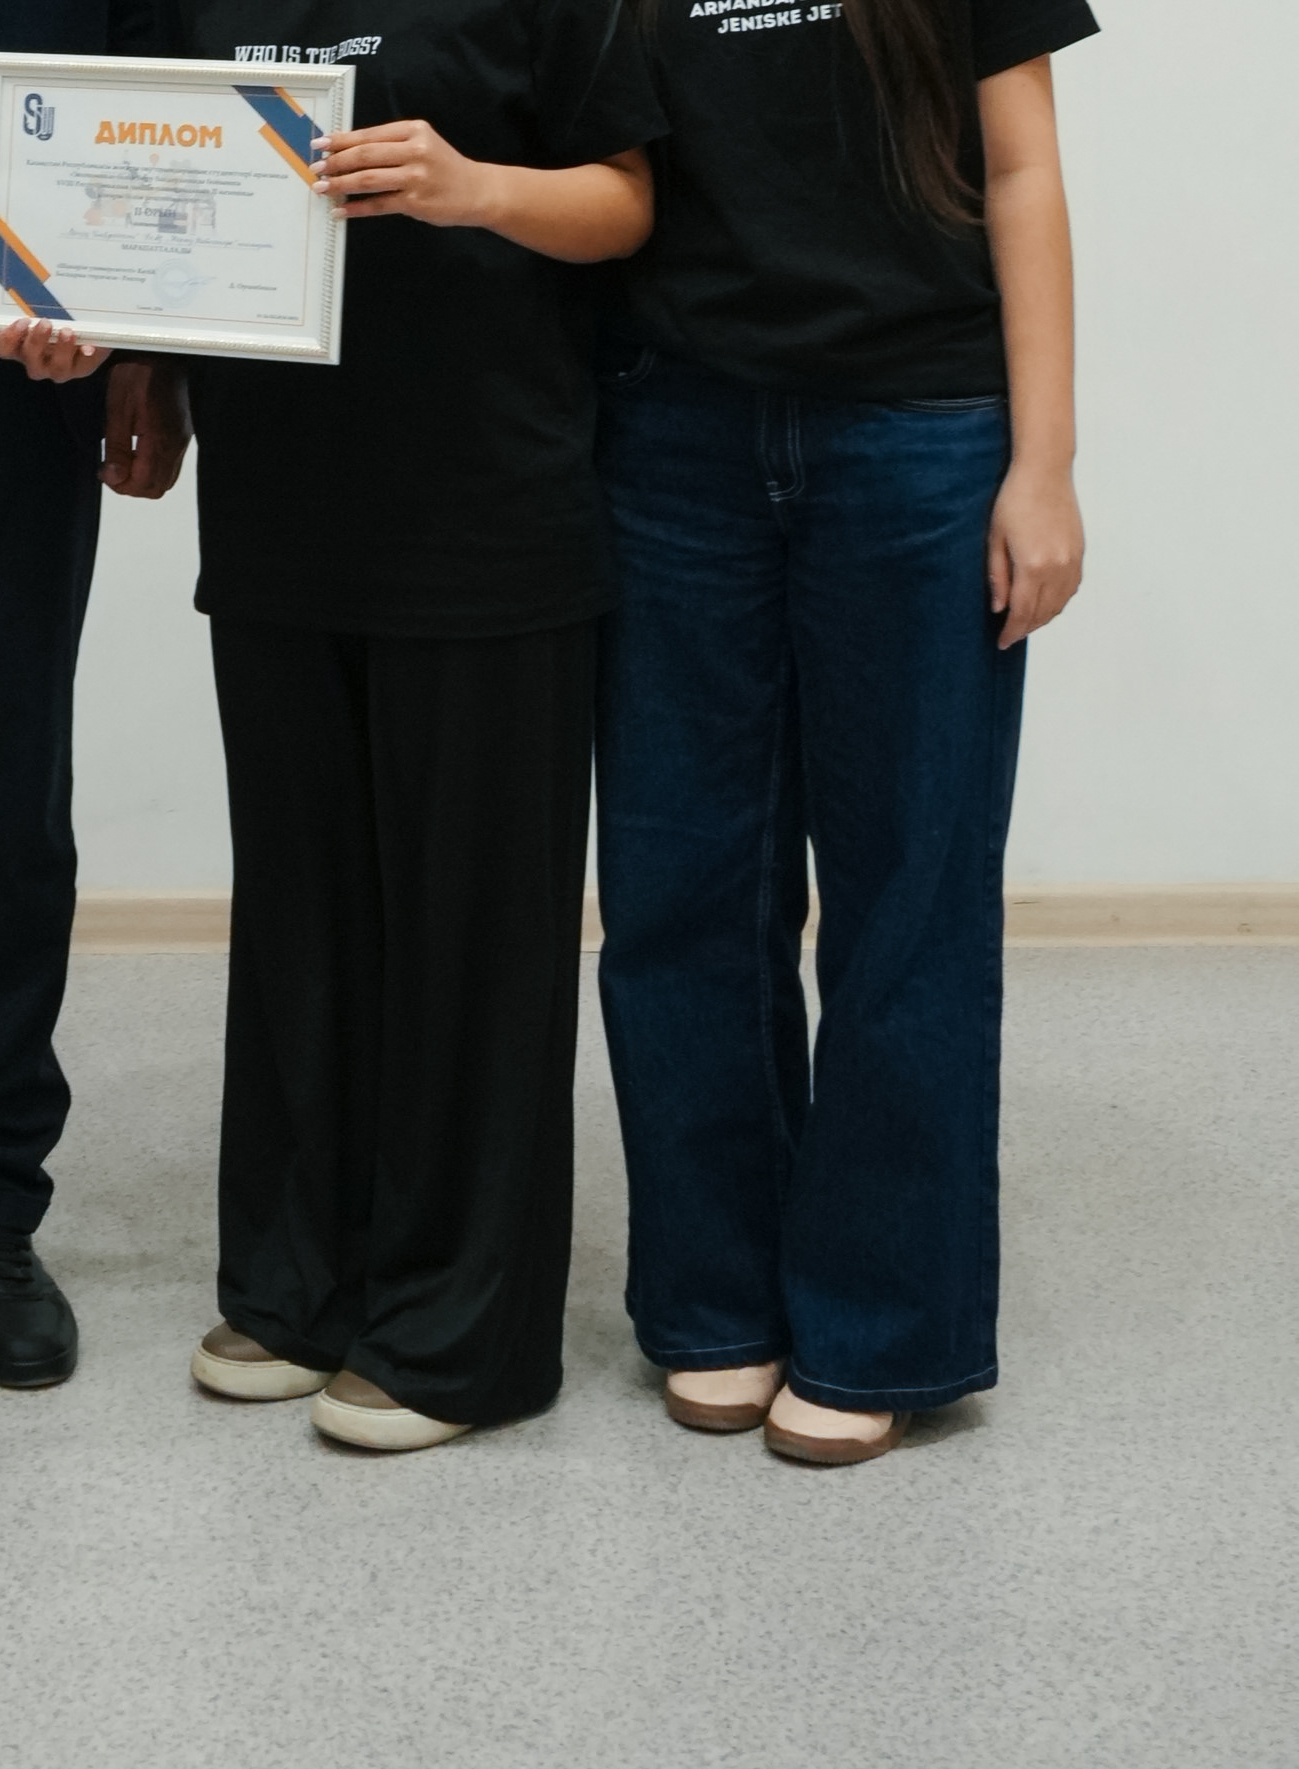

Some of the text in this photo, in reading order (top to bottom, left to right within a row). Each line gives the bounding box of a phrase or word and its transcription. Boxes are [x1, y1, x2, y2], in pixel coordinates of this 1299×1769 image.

[717, 9, 802, 34] JENISKE
[235, 36, 382, 64] WHO IS THE BOSS?
[95, 120, 223, 149] ДИПЛОМ
